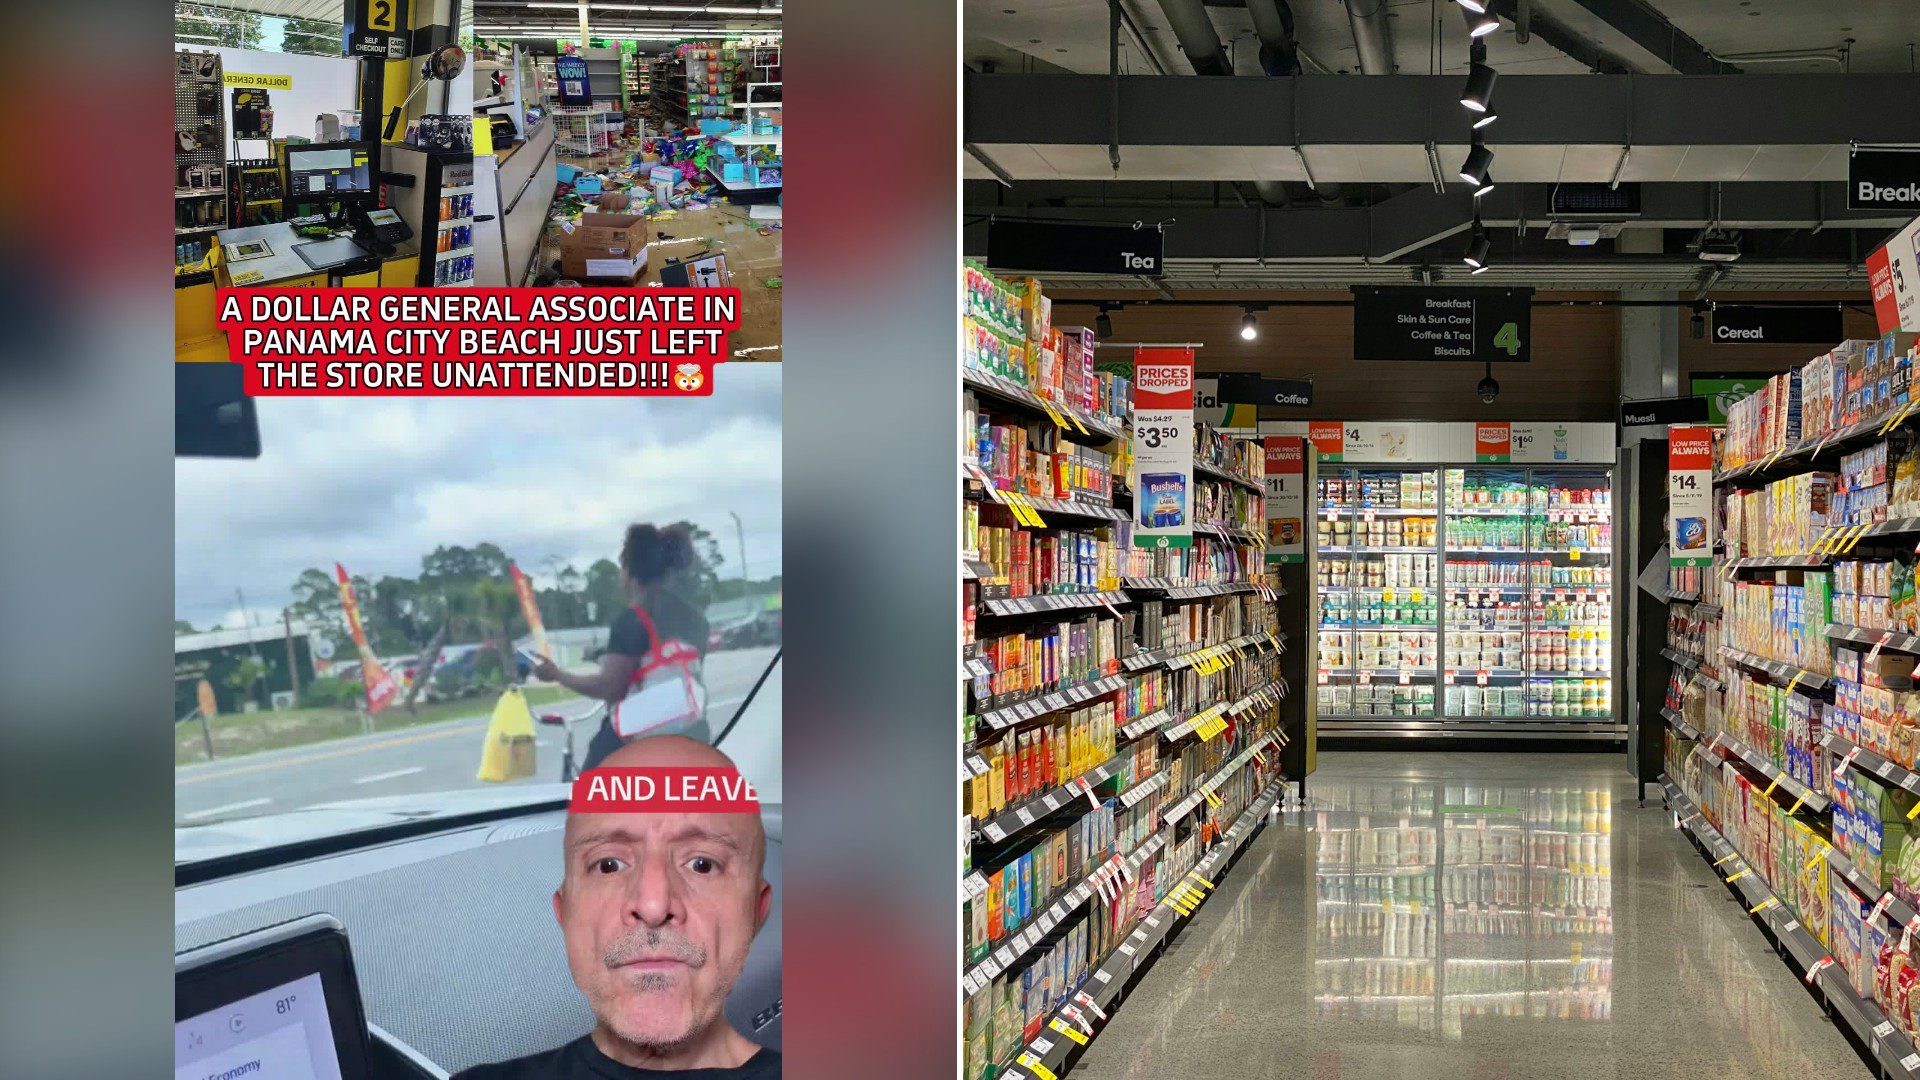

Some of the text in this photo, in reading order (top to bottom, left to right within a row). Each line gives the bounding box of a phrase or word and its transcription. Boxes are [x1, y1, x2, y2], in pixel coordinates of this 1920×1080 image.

[373, 0, 391, 27] 2
[364, 36, 379, 45] SELF
[355, 43, 387, 53] CHECKOUT
[558, 67, 587, 79] WOW!
[1858, 181, 1920, 202] Break
[1121, 252, 1155, 269] Tea
[1425, 299, 1472, 309] Breakfast
[1397, 314, 1471, 325] Skin & Sun Care
[1411, 330, 1471, 340] Coffee & Tea
[1717, 326, 1764, 339] Cereal
[1493, 322, 1521, 356] 4
[1434, 346, 1471, 356] Biscuits
[1140, 368, 1189, 379] PRICES
[1139, 379, 1189, 387] DROPPED
[1275, 393, 1309, 405] Coffee
[1625, 413, 1656, 424] Muesli
[1345, 428, 1360, 442] $4
[1671, 447, 1710, 455] ALWAYS
[1267, 479, 1284, 491] $11
[1672, 475, 1697, 490] $14
